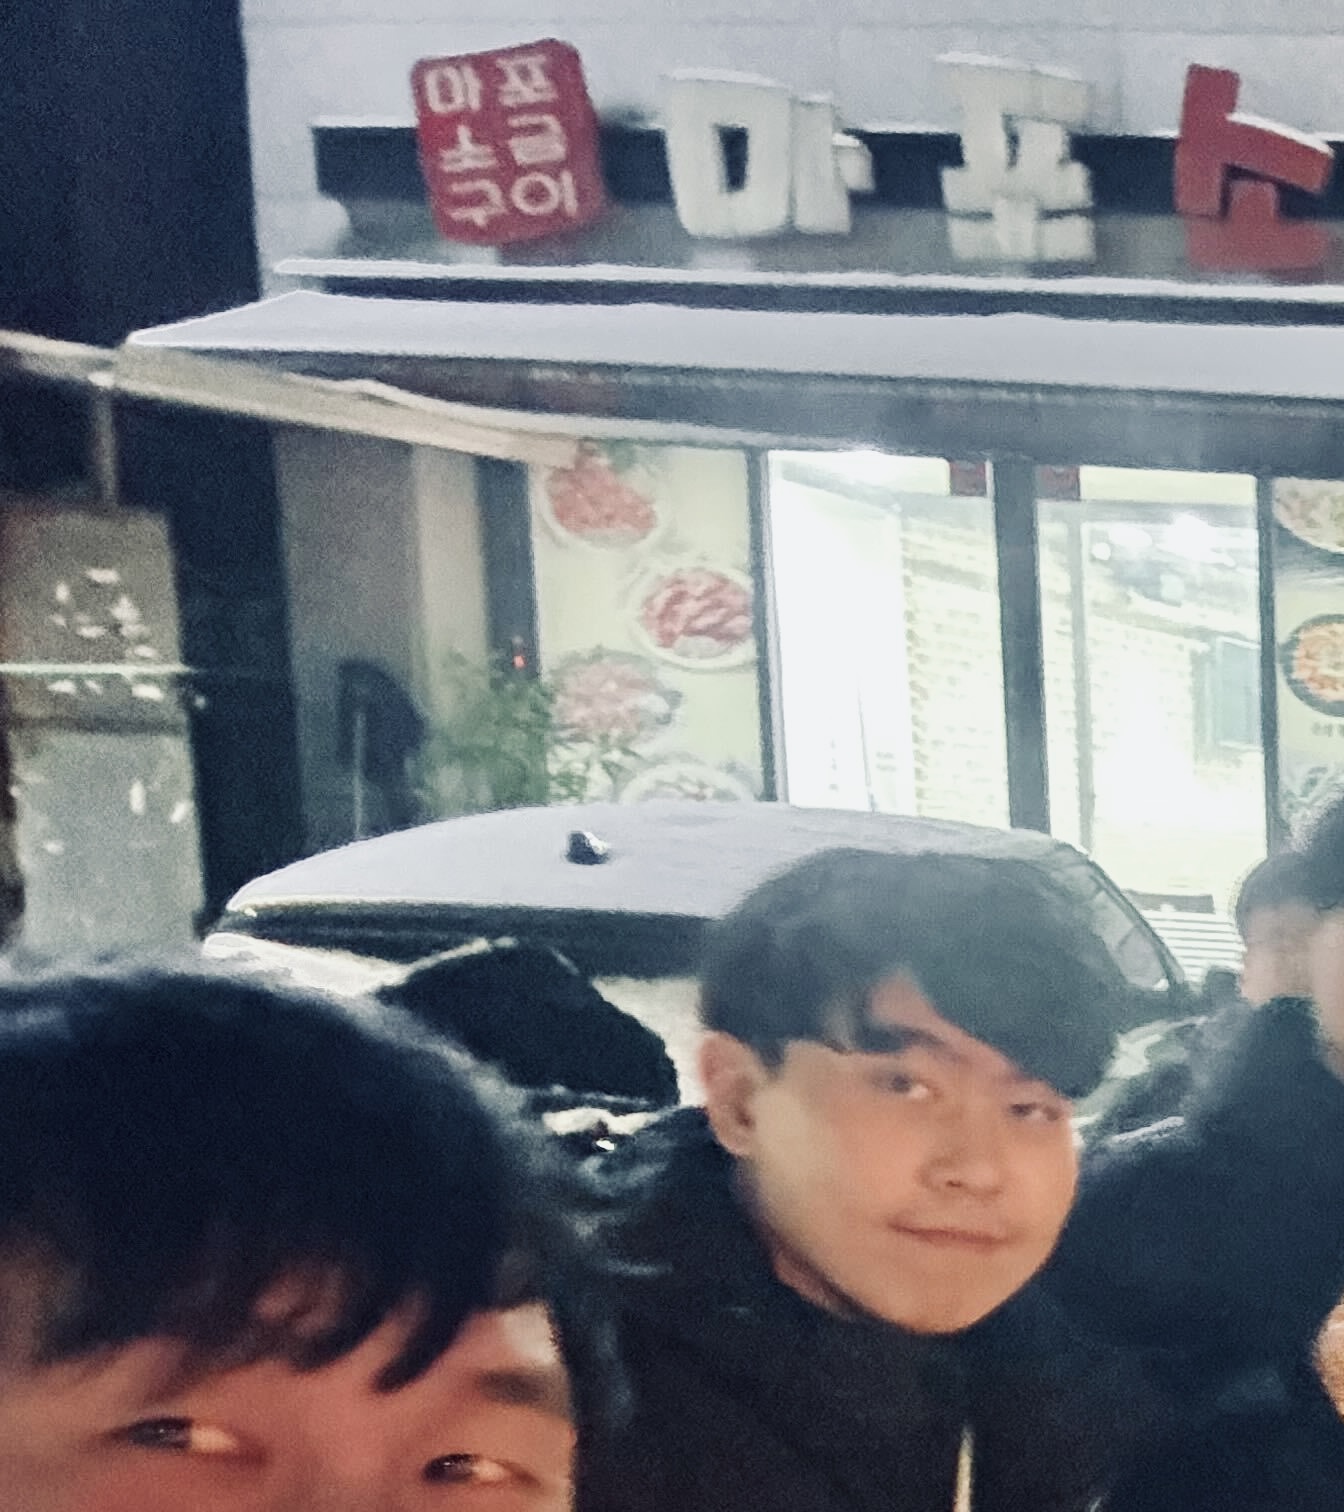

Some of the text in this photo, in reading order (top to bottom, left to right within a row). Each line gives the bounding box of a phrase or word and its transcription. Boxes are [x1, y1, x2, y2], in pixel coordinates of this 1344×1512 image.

[424, 55, 559, 114] 마포
[439, 113, 568, 173] 소금
[449, 167, 579, 230] 구이
